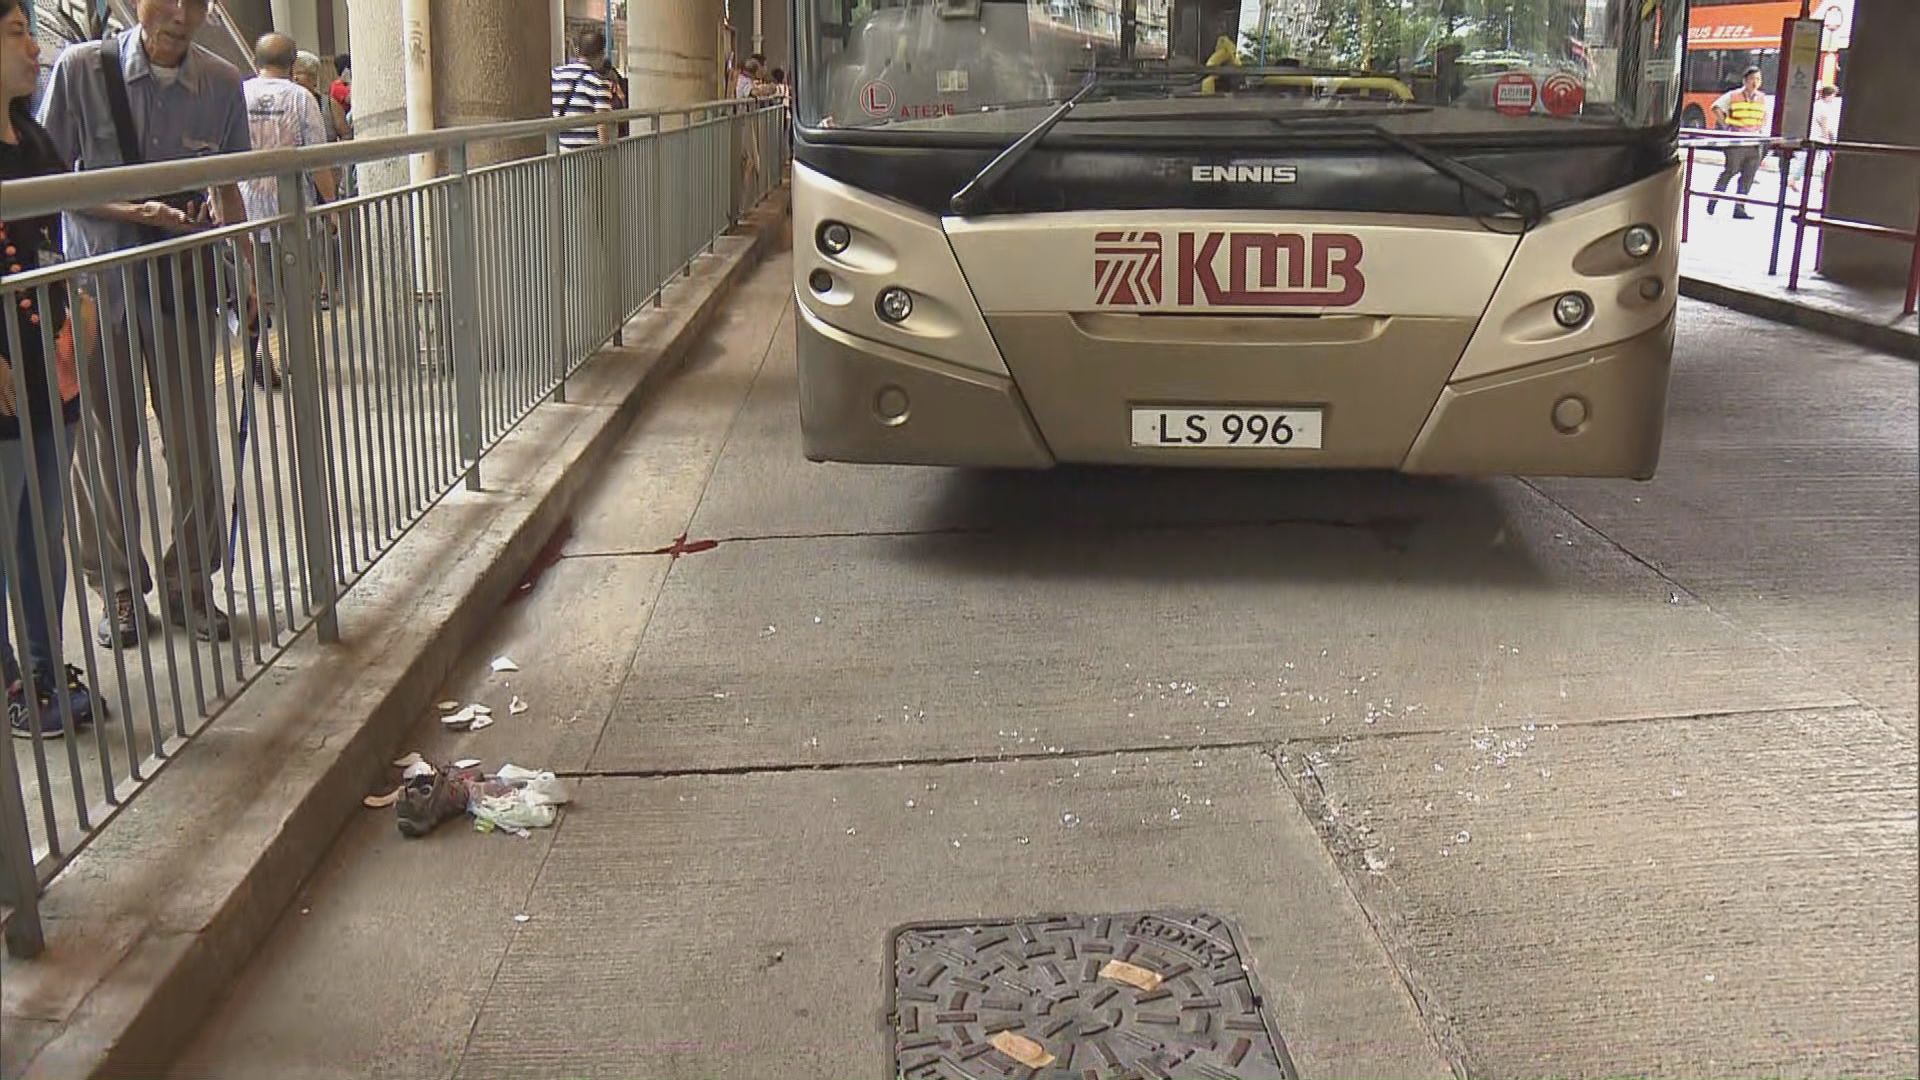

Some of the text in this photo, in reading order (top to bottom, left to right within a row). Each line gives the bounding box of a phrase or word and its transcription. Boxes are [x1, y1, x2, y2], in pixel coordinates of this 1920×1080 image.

[868, 86, 888, 112] L
[1191, 165, 1296, 183] ENNIS
[1177, 231, 1365, 306] KMB
[1159, 413, 1293, 445] LS 996
